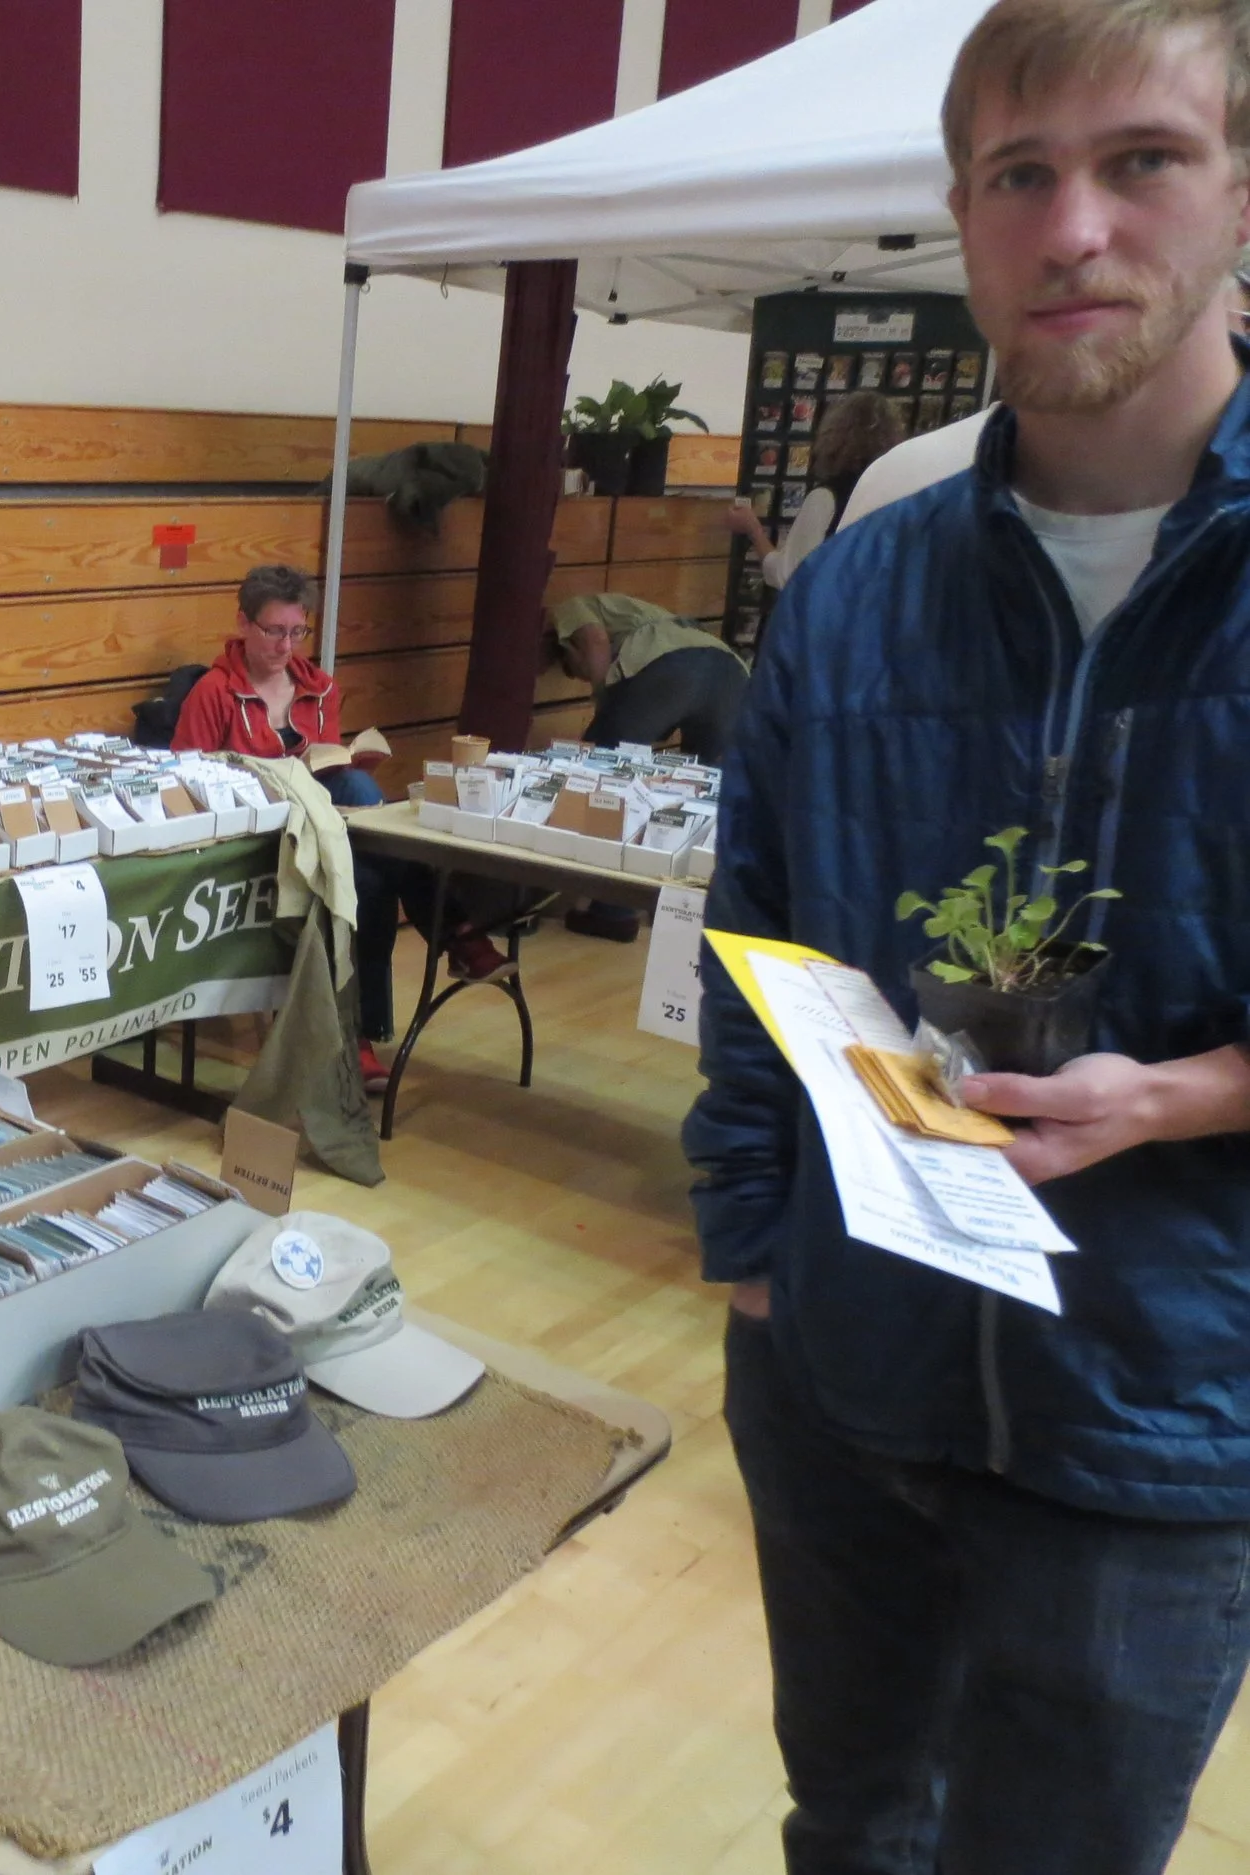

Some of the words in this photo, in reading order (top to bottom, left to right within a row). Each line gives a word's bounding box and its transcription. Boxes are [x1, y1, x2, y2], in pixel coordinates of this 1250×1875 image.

[233, 1164, 269, 1187] BETTER
[271, 1181, 289, 1197] THE
[239, 1399, 289, 1418] SEEDS
[7, 1468, 112, 1529] RESTORATION
[56, 1496, 100, 1527] SEEDS
[240, 1776, 272, 1808] Seed
[275, 1751, 319, 1787] Packets
[262, 1797, 294, 1838] $4
[165, 1835, 213, 1875] ATION
